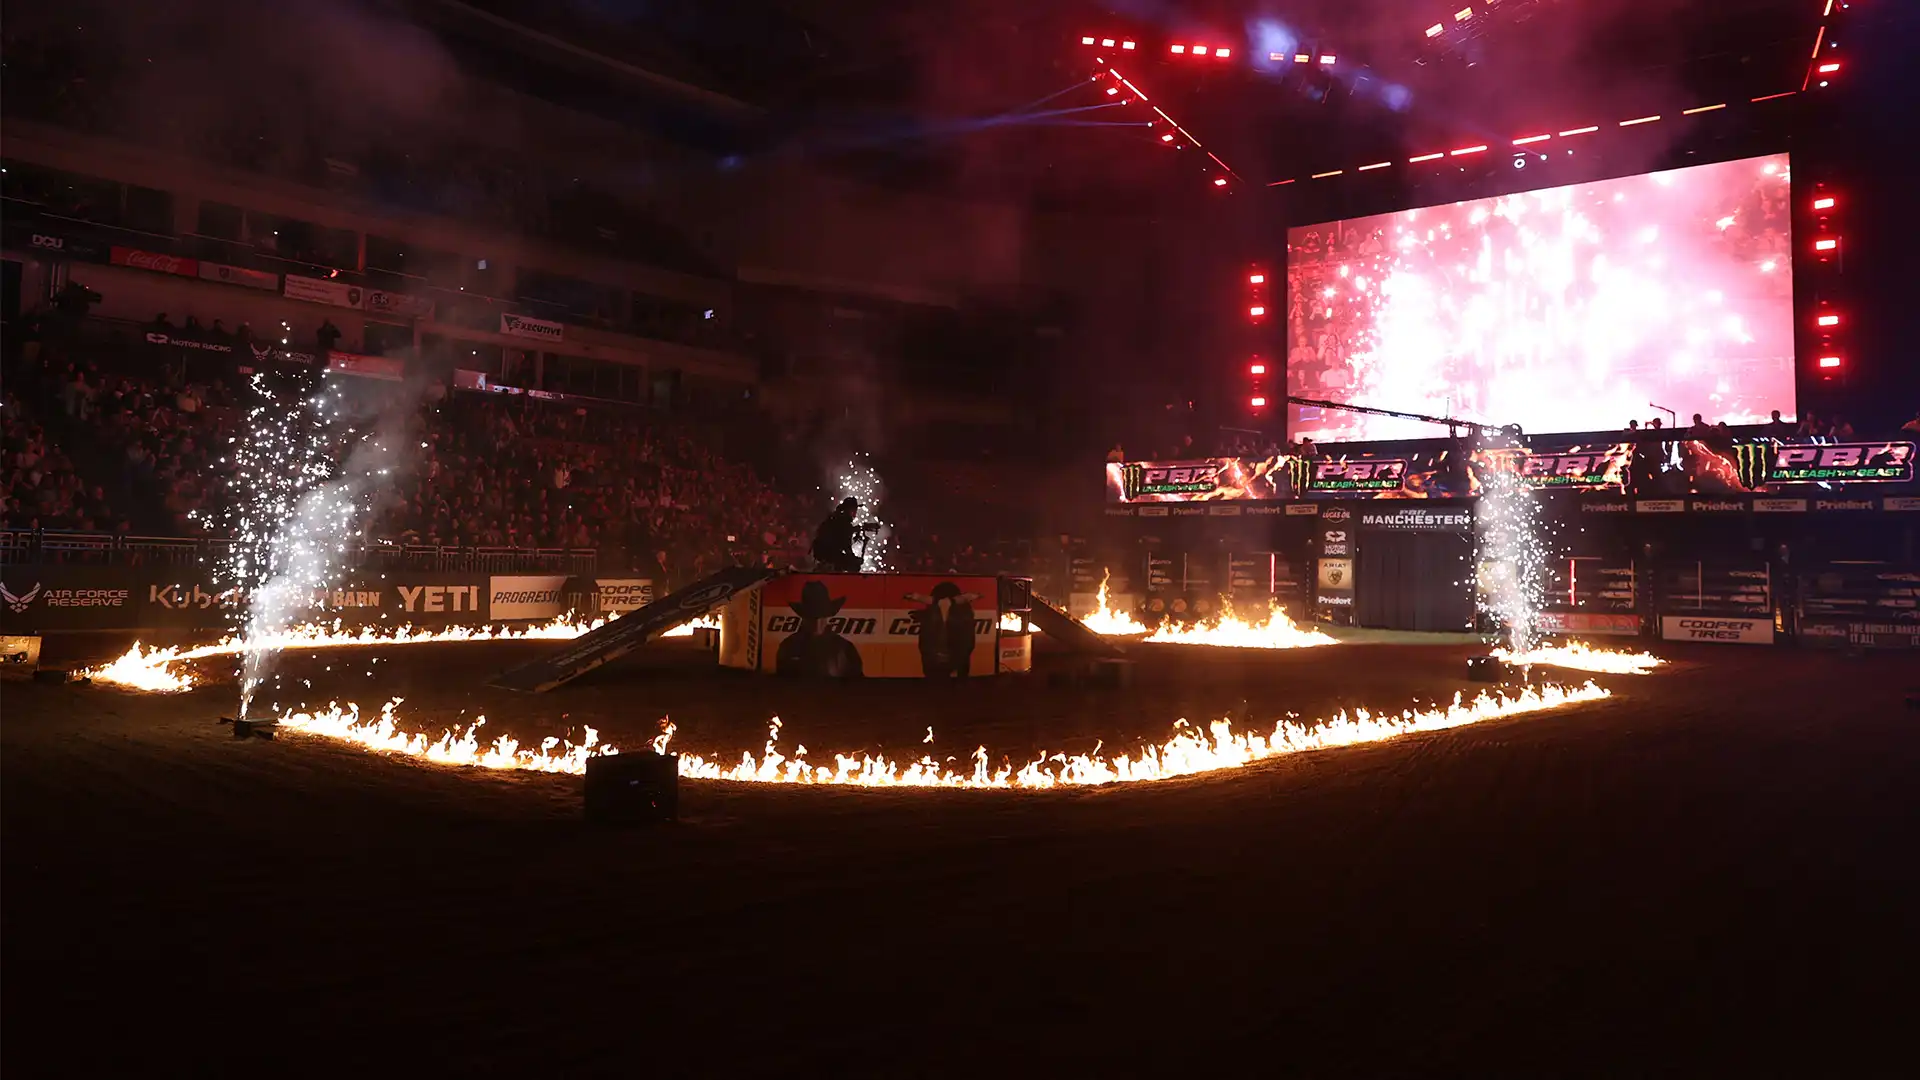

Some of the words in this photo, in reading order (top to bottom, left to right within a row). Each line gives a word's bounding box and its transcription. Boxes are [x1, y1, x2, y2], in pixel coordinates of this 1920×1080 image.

[171, 338, 200, 349] MOTOR
[202, 343, 232, 353] RACING
[1776, 446, 1911, 467] PBR
[1144, 468, 1217, 484] PBR
[1315, 463, 1404, 481] PBR
[1772, 470, 1836, 479] UNLEASH
[1856, 468, 1904, 477] BEAST
[1312, 481, 1356, 489] UNLEASH
[1368, 480, 1400, 488] BEAST
[1581, 502, 1629, 513] Priefert
[1692, 501, 1745, 512] Priefert
[1815, 500, 1874, 511] Priefert
[1362, 515, 1465, 525] MANCHESTER
[43, 589, 73, 600] AIR
[76, 589, 129, 600] FORCE
[332, 591, 381, 608] BARN
[397, 585, 480, 613] YETI
[602, 595, 649, 605] TIRES
[1318, 595, 1352, 605] Priefert
[47, 598, 124, 608] RESERVE
[1679, 619, 1754, 631] COOPER
[1688, 629, 1741, 640] TIRES
